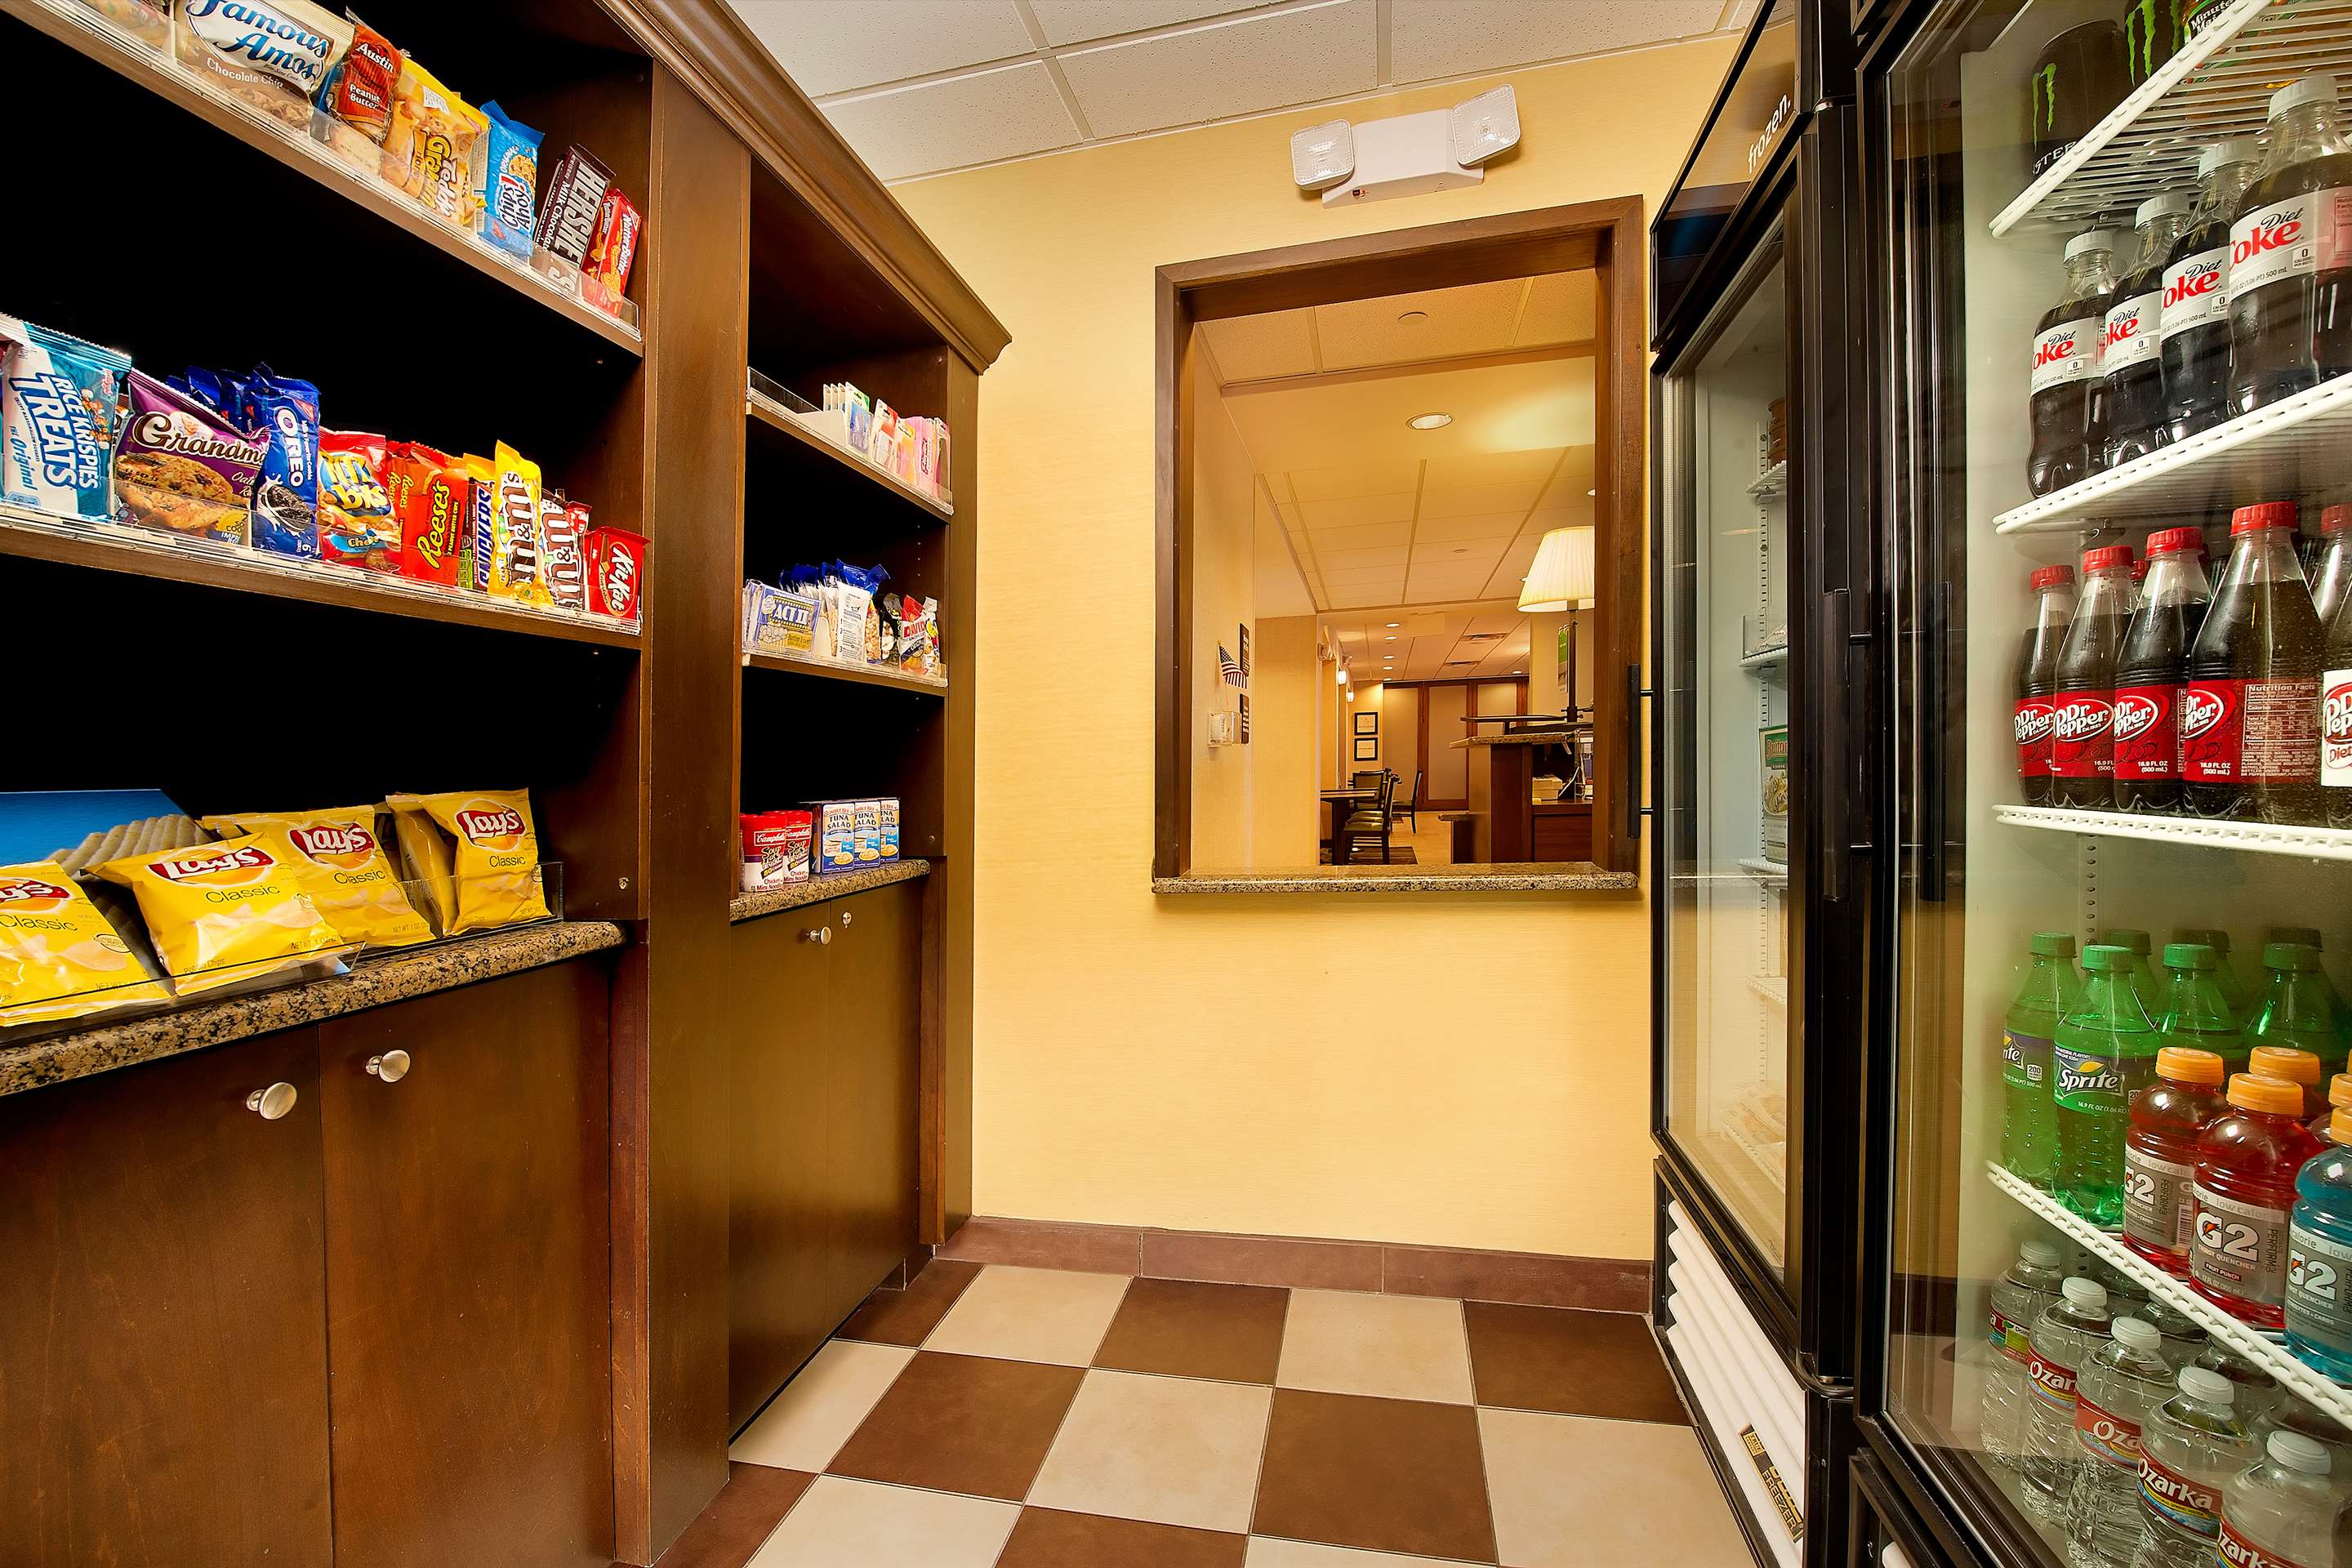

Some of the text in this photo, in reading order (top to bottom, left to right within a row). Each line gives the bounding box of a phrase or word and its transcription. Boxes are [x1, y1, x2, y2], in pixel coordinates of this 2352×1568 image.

[355, 42, 394, 74] Austin
[207, 57, 284, 90] Chocolate Chip
[350, 83, 381, 103] Peanut
[350, 92, 380, 110] Butter
[497, 181, 517, 229] Chips
[2261, 207, 2305, 230] Diet
[2301, 248, 2309, 257] 0
[2185, 258, 2222, 279] Diet
[2266, 270, 2278, 279] 500
[2219, 296, 2225, 305] 0
[2113, 306, 2140, 324] Diet
[2189, 314, 2198, 323] 500
[2048, 330, 2077, 345] Diet
[2032, 340, 2076, 370] oke
[8, 372, 78, 490] TREATS
[51, 375, 100, 489] RICE KRISPIES
[274, 406, 305, 488] OREO
[10, 436, 38, 492] Original
[416, 479, 450, 569] Reese's
[773, 604, 795, 624] ACT
[903, 620, 925, 638] DAVID
[2066, 704, 2091, 722] Dr
[2339, 692, 2352, 715] D
[2014, 712, 2055, 742] Pepper
[2019, 709, 2038, 726] Dr
[2054, 708, 2109, 738] Pepper
[2114, 706, 2152, 737] pper
[462, 810, 519, 839] Lay's
[827, 822, 851, 831] SALAD
[830, 814, 849, 822] TUNA
[300, 826, 368, 855] Lay's
[489, 855, 526, 867] Classic
[333, 869, 385, 884] Classic
[205, 884, 281, 904] Classic
[0, 913, 78, 932] Classic
[2028, 1066, 2042, 1074] 200
[2058, 1068, 2118, 1096] Sprite
[2216, 1198, 2235, 1211] low
[2196, 1211, 2260, 1263] G2
[2267, 1227, 2278, 1267] PERFORM
[2292, 1228, 2317, 1250] alorie
[2216, 1252, 2256, 1272] QUENCHER
[2219, 1268, 2240, 1281] PUNCH
[2288, 1248, 2338, 1301] G2
[2029, 1361, 2076, 1392] Ozar
[2093, 1420, 2140, 1450] Oza
[2137, 1457, 2213, 1510] Ozarka
[1762, 1469, 1798, 1530] FREEZER
